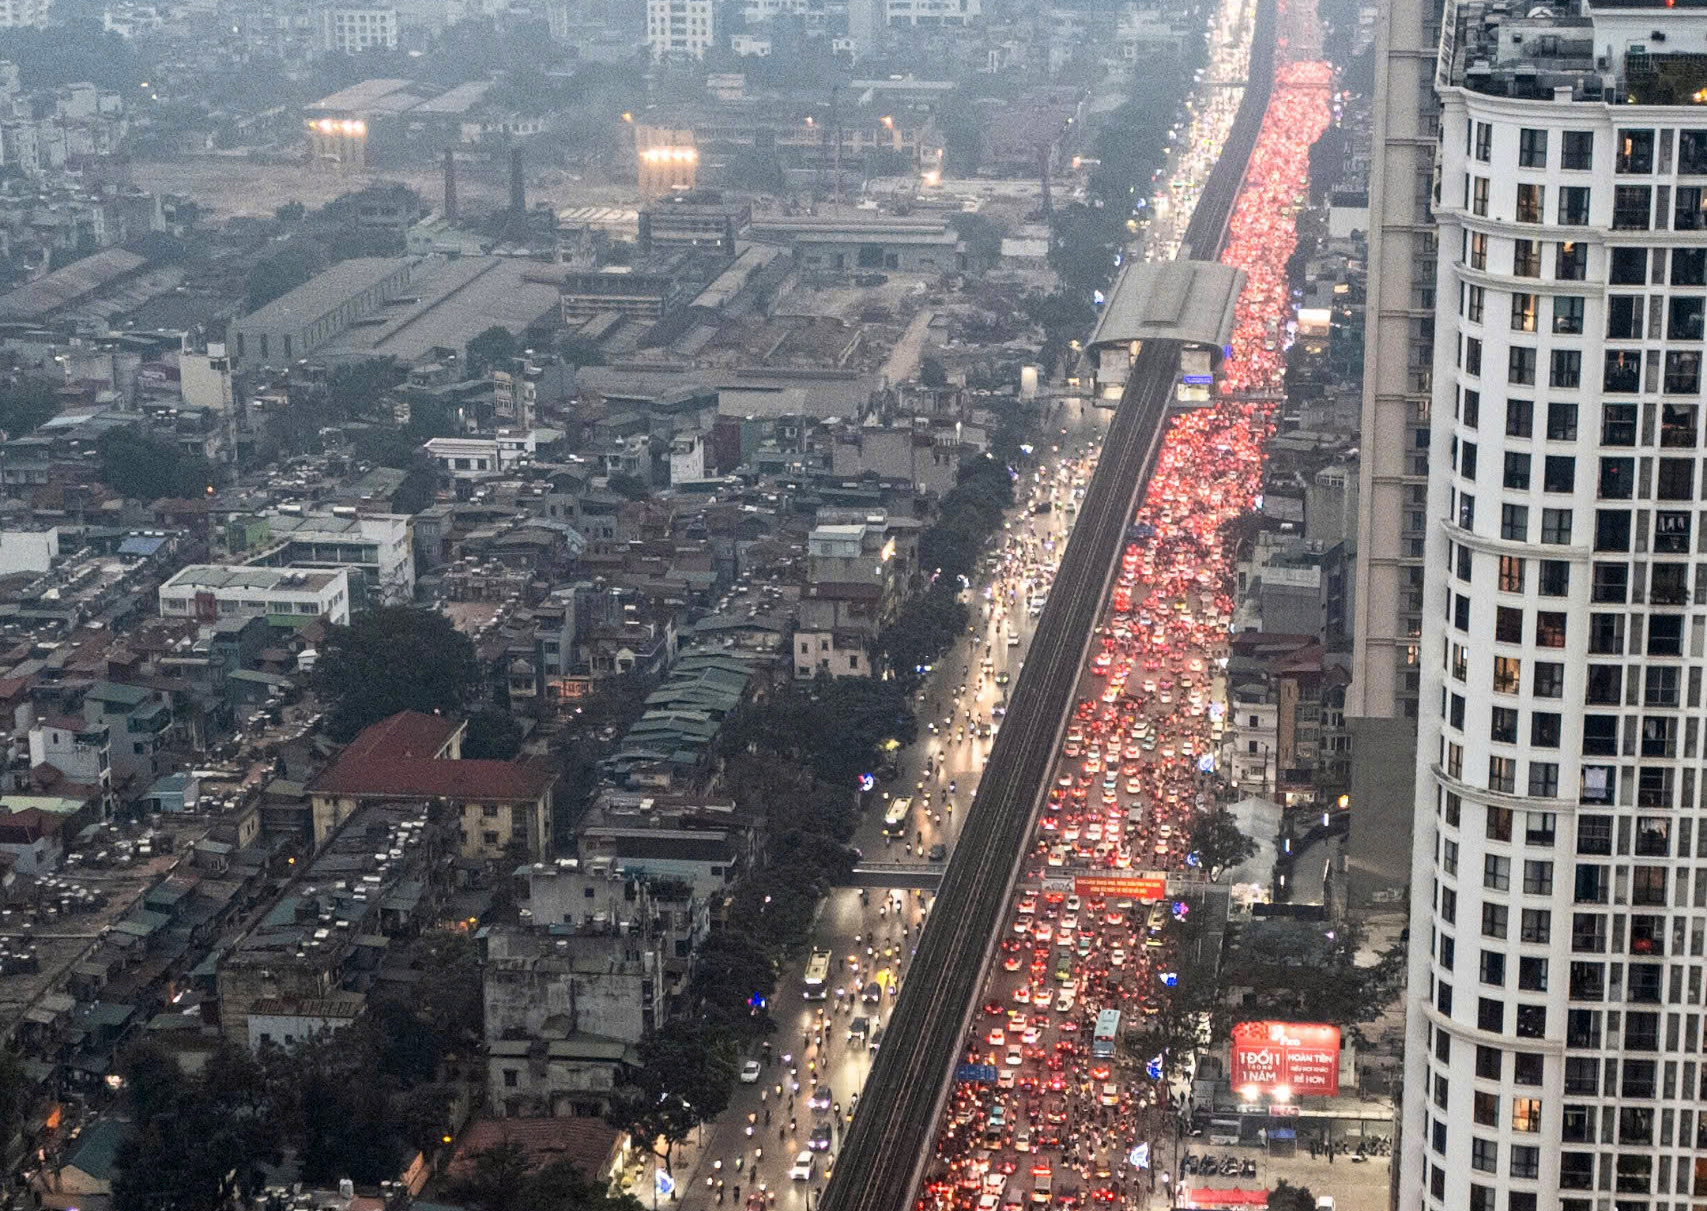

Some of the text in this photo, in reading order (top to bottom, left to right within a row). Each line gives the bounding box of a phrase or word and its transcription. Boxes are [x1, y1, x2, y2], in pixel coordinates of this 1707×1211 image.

[1240, 1048, 1280, 1066] 1 ĐỔI 1
[1243, 1072, 1247, 1081] 1
